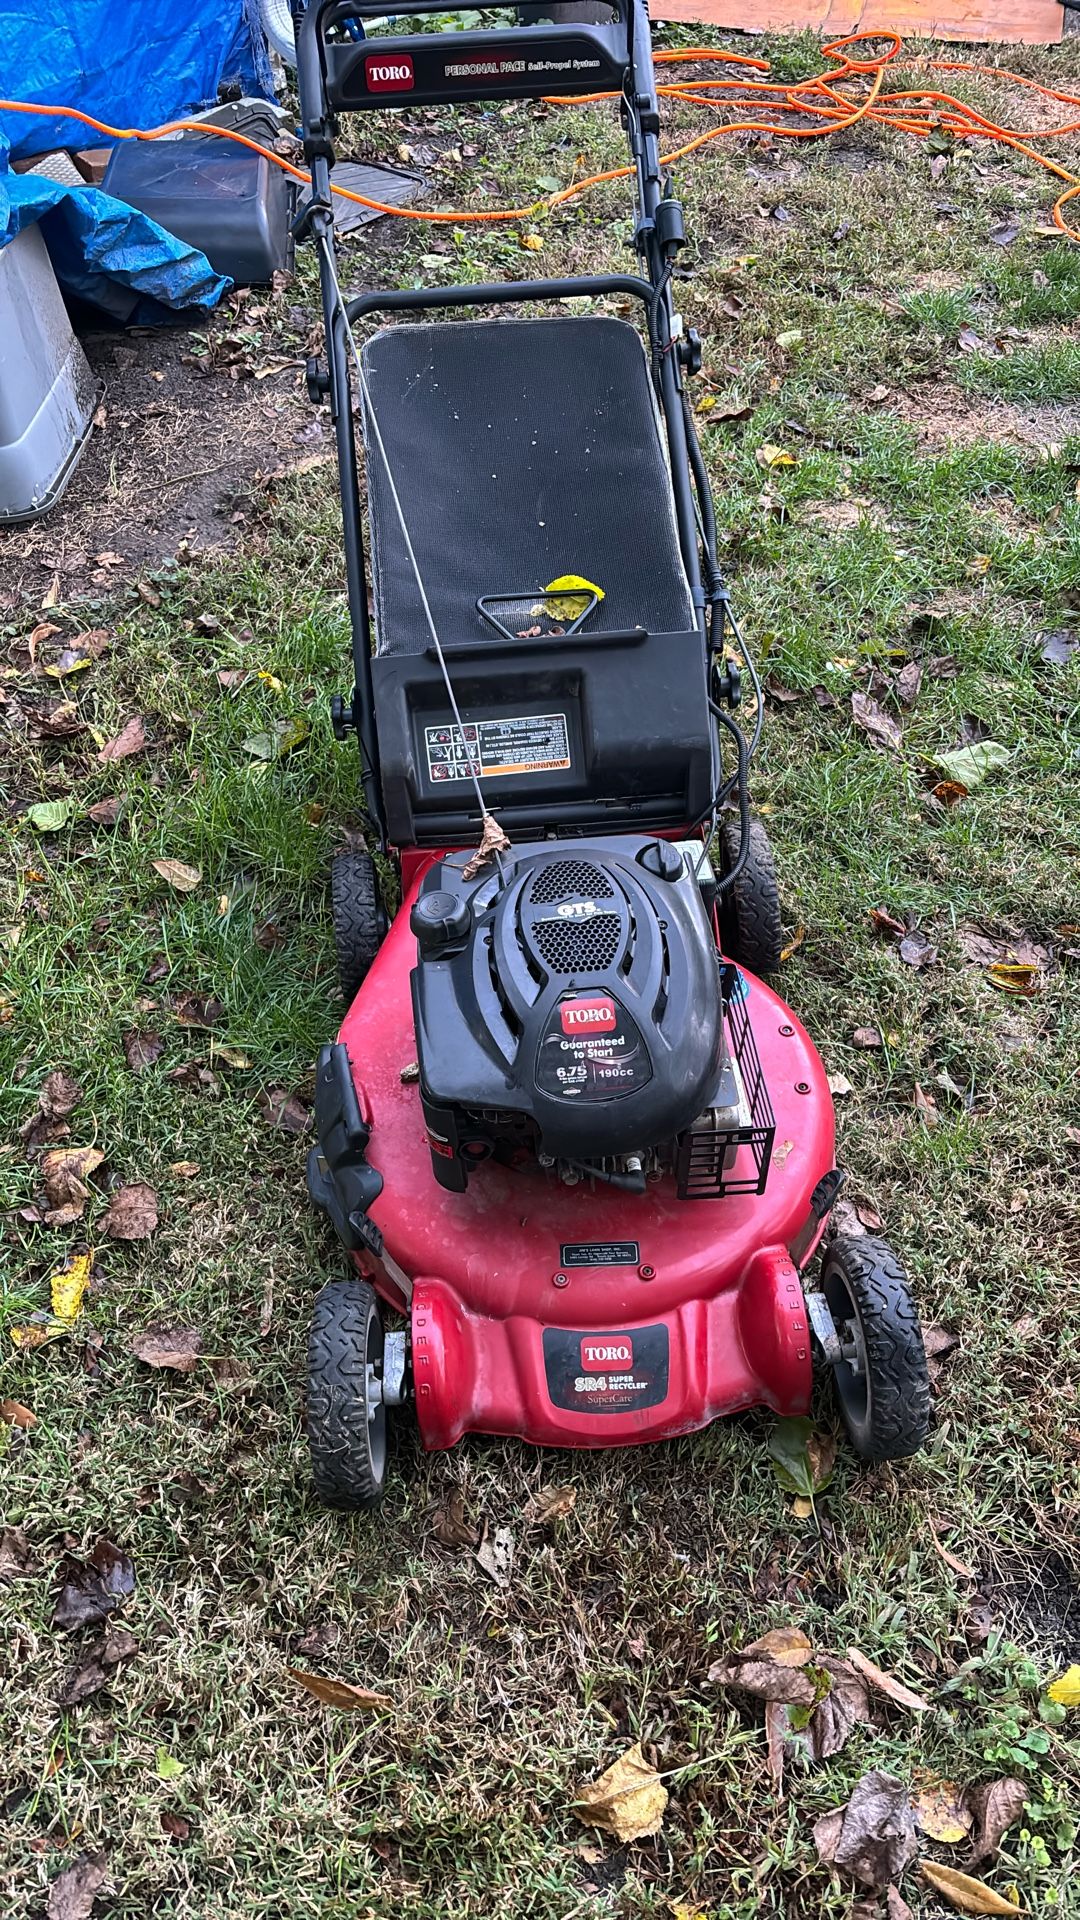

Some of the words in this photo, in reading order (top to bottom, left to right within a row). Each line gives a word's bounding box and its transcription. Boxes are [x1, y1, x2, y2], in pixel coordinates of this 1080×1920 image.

[369, 64, 412, 81] TORO
[444, 62, 498, 77] PERSONAL
[499, 60, 526, 73] PACE
[528, 60, 571, 72] Self-Propel
[572, 59, 601, 70] System
[524, 760, 561, 771] WARNING
[557, 901, 597, 916] GTS
[565, 1007, 612, 1024] TORO
[560, 1035, 625, 1050] Guaranteed
[573, 1050, 585, 1059] to
[587, 1047, 613, 1058] Start
[556, 1065, 587, 1078] 6.75
[598, 1068, 634, 1078] 190cc
[584, 1346, 630, 1361] TORO
[574, 1376, 607, 1392] SR4
[608, 1375, 634, 1383] SUPER
[609, 1382, 647, 1390] RECYCLER
[587, 1393, 633, 1405] SuperCare
